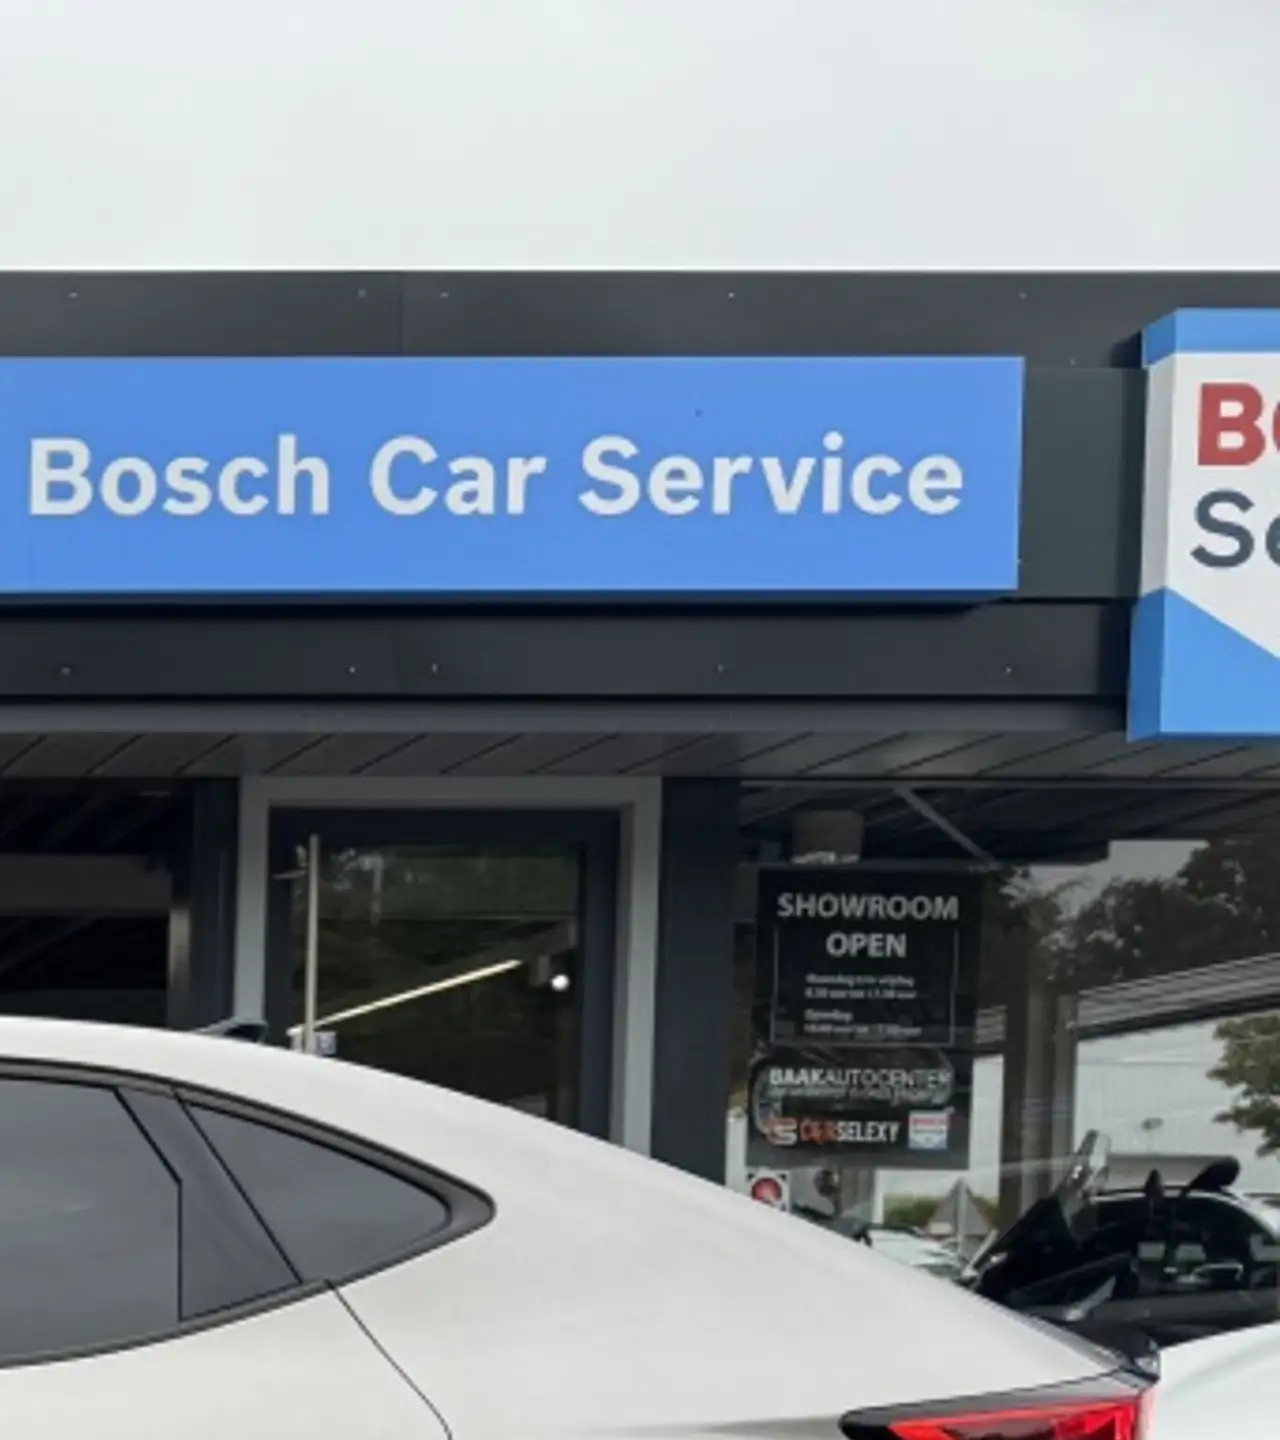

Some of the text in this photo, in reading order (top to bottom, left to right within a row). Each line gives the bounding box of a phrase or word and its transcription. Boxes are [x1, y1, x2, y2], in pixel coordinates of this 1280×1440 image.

[1198, 382, 1280, 467] B
[29, 431, 964, 516] Bosch Car Service
[777, 892, 960, 921] SHOWROOM
[826, 932, 908, 958] OPEN
